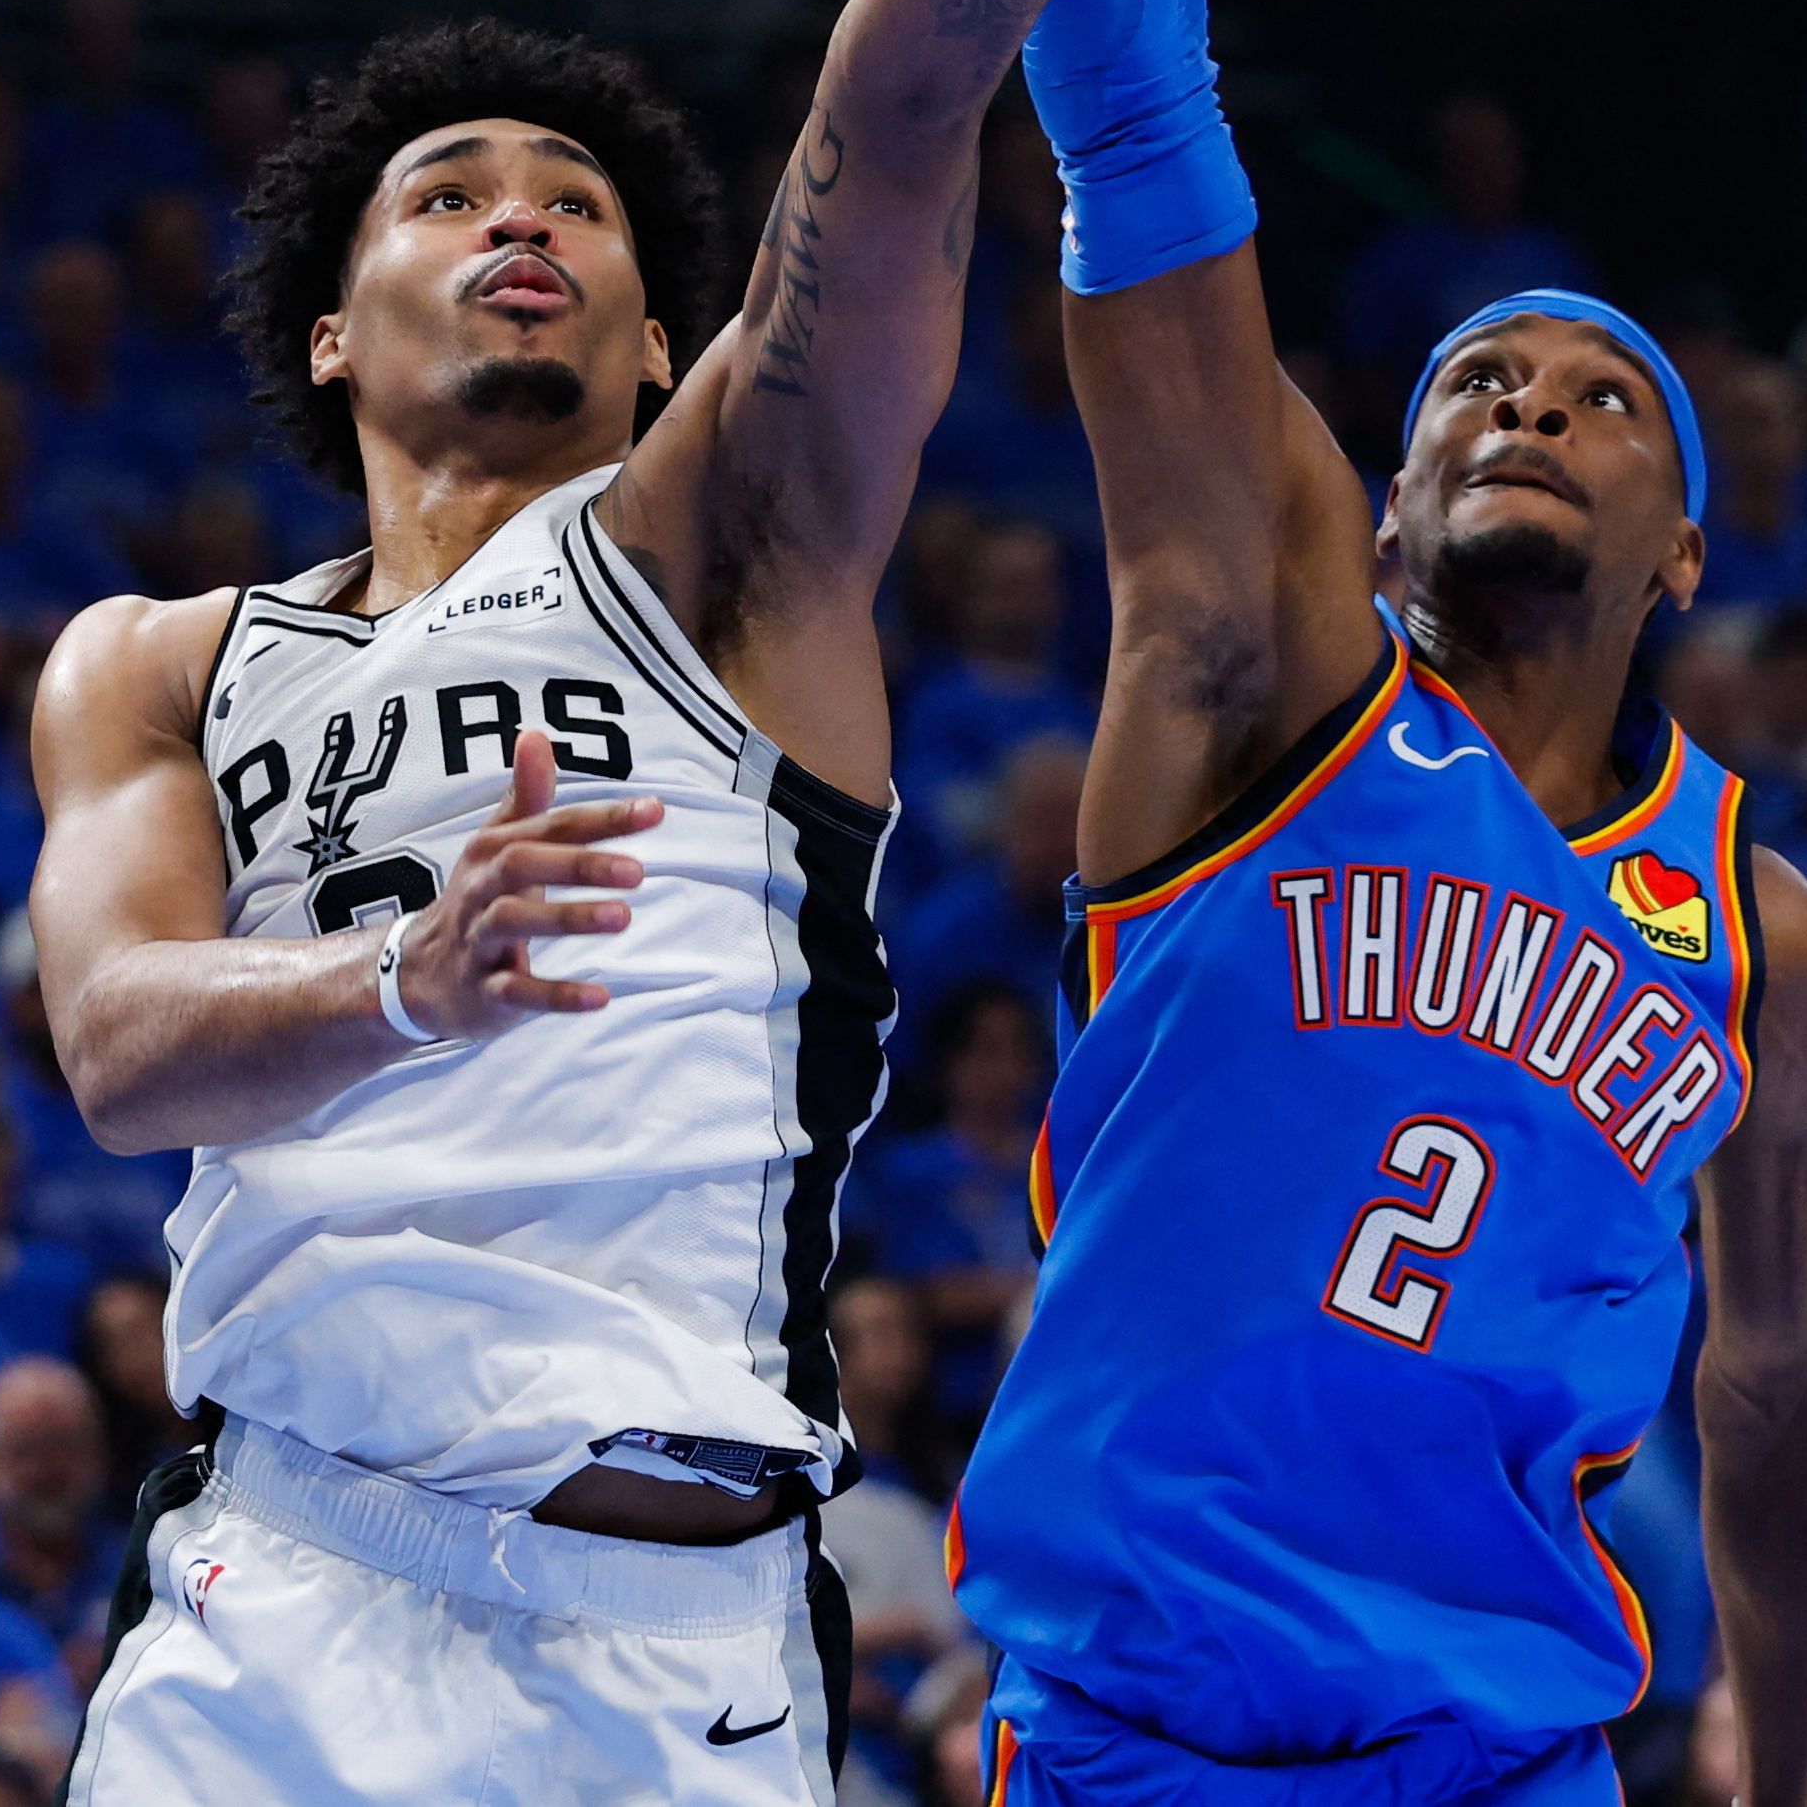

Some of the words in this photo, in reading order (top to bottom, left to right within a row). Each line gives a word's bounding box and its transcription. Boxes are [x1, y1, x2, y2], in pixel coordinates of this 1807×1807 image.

[446, 585, 544, 619] LEDGER
[218, 678, 633, 878] PURS
[1270, 865, 1727, 1185] THUNDER
[1625, 916, 1701, 953] oves
[1320, 1113, 1496, 1354] 2
